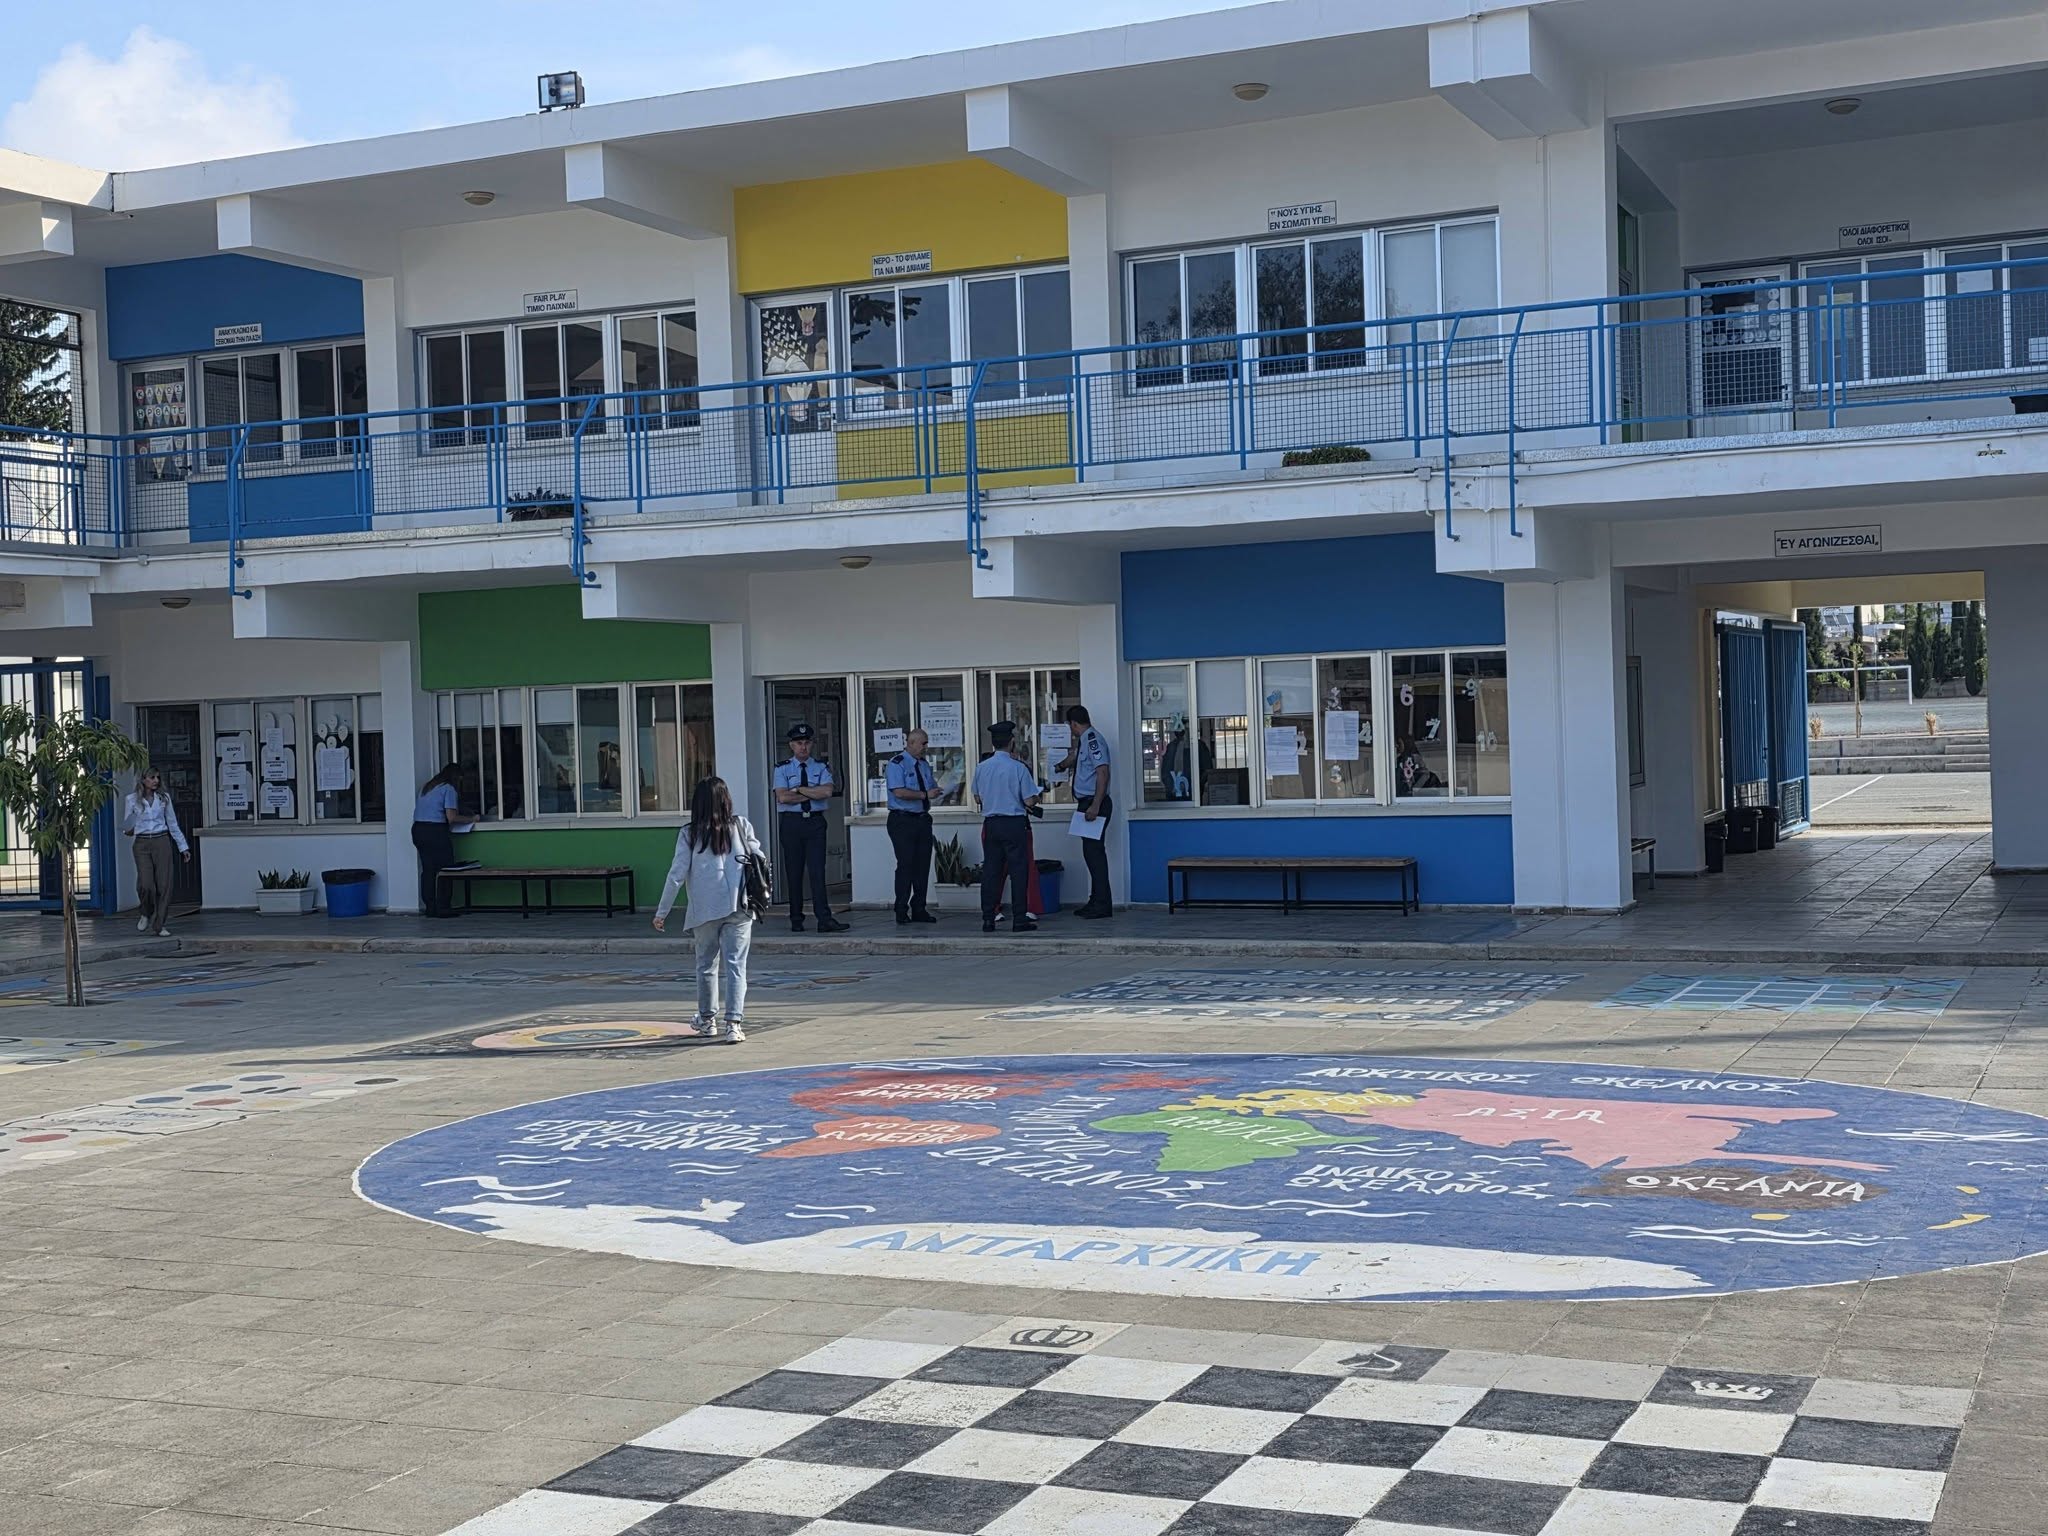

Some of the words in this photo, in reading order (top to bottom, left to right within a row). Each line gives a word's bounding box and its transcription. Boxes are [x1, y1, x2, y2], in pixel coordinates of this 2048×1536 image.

[1300, 205, 1323, 214] ΥΓΙΗΣ
[1269, 222, 1280, 230] ΕΝ
[1282, 218, 1310, 228] ΣΩΜΑΤΙ
[873, 256, 890, 265] ΝΕΡΟ
[874, 267, 885, 276] ΓΙΑ
[885, 266, 894, 275] ΝΑ
[895, 265, 905, 273] ΜΗ
[550, 293, 566, 301] PLAY
[1400, 684, 1414, 706] 6
[1359, 721, 1372, 744] 4
[1296, 1067, 1541, 1084] ΑΡΚΤΙΚΟΣ
[872, 1083, 997, 1094] ΒΟΡΕΙΑ
[835, 1089, 994, 1101] ΑΜΕΡΙΚΗ
[1452, 1107, 1605, 1124] ΑΣΙΑ
[514, 1120, 788, 1136] ΕΙΡΗΝΙΚΟΣ
[840, 1122, 961, 1132] ΝΟΤΙΑ
[1154, 1116, 1331, 1146] ΑΦΡΙΚΗ
[816, 1131, 986, 1143] ΑΜΕΡΙΚΗ
[1295, 1164, 1500, 1184] ΙΝΔΙΚΟΣ
